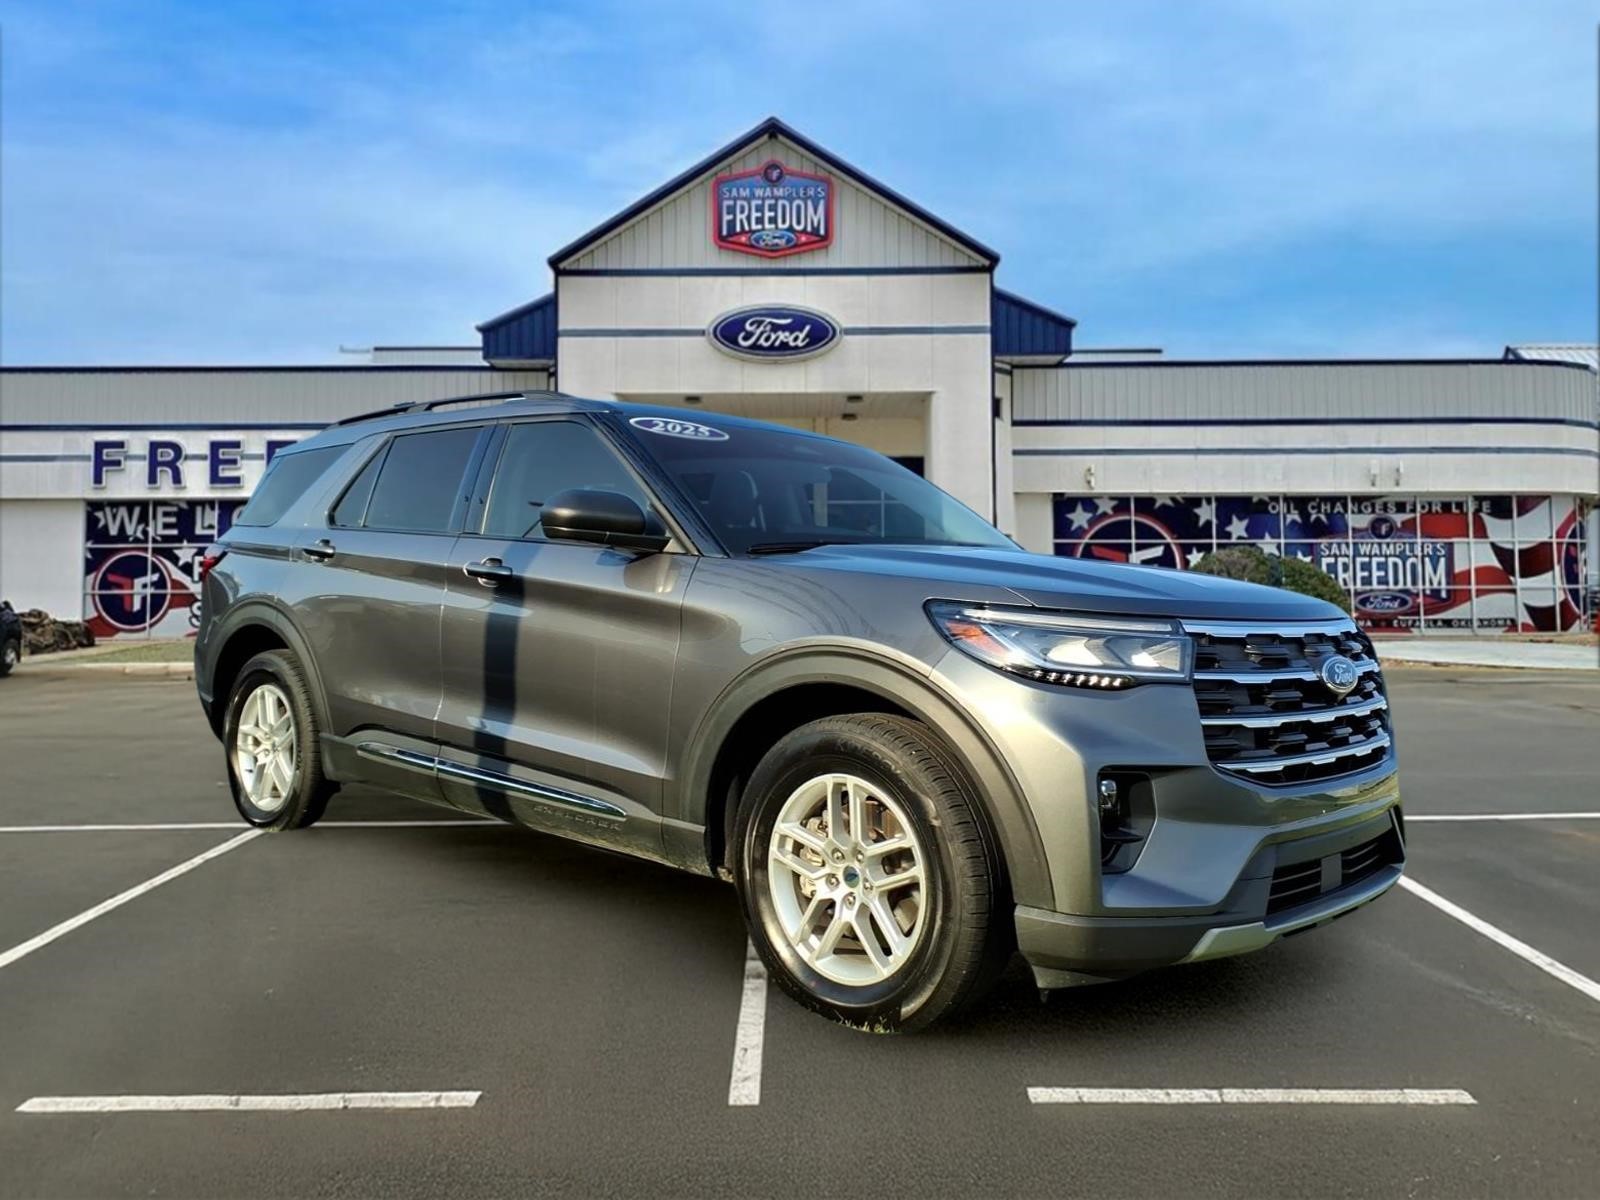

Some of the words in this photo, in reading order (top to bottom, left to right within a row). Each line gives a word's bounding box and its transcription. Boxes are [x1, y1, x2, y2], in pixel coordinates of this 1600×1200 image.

[722, 188, 750, 198] SAM
[722, 199, 826, 236] FREEDOM
[760, 231, 787, 247] Ford
[738, 317, 810, 347] Ford
[651, 420, 711, 437] 2025
[1268, 501, 1299, 514] OIL
[1307, 500, 1396, 514] CHANGES
[1406, 500, 1444, 514] FOR
[1452, 500, 1492, 514] LIFE
[104, 505, 248, 538] WEL
[1320, 556, 1447, 599] FREEDOM
[1365, 594, 1401, 610] Ford
